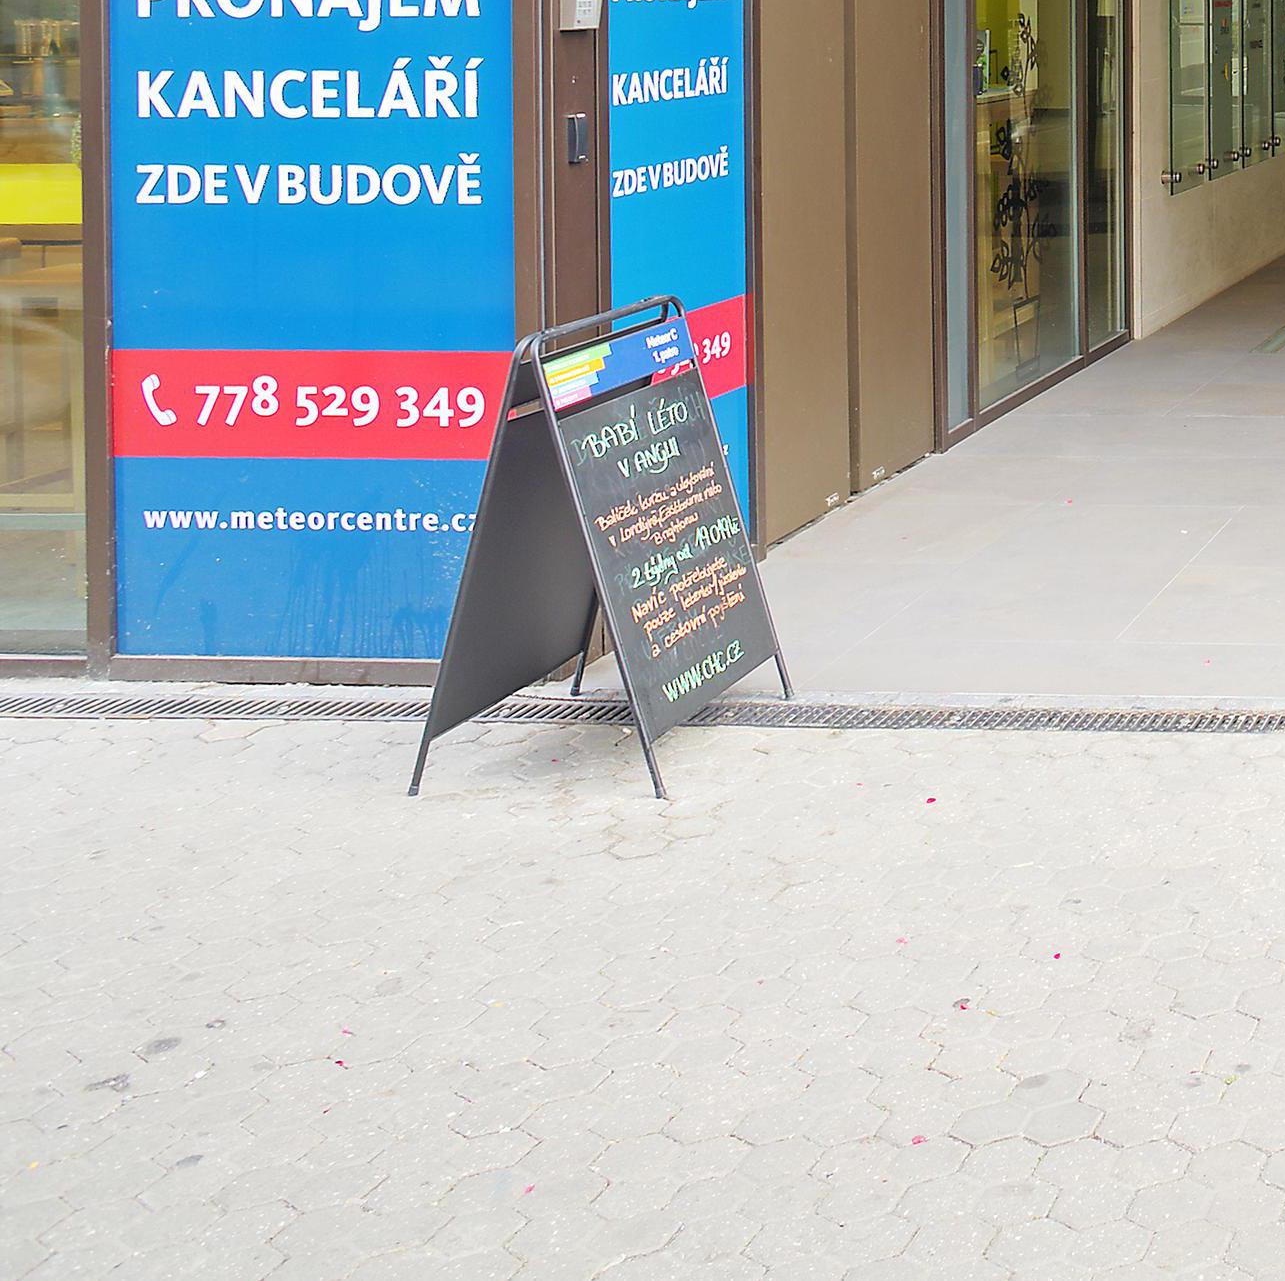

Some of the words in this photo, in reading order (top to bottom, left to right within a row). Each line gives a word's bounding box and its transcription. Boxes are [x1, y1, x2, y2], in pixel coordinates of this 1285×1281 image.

[137, 55, 485, 119] KANCELÁŘÍ
[612, 57, 729, 107] KANCELÁŘÍ
[135, 163, 229, 205] ZDE
[234, 163, 271, 205] V
[277, 152, 483, 206] BUDOVĚ
[612, 166, 647, 198] ZDE
[648, 165, 662, 191] V
[661, 145, 729, 189] BUDOVĚ
[702, 331, 731, 365] 349
[194, 375, 280, 427] 778
[295, 385, 380, 428] 529
[394, 386, 486, 428] 349
[582, 404, 639, 458] BABÍ
[647, 398, 688, 435] LÉTO
[617, 459, 629, 478] V
[631, 568, 645, 589] 2
[631, 589, 667, 623] Navíc
